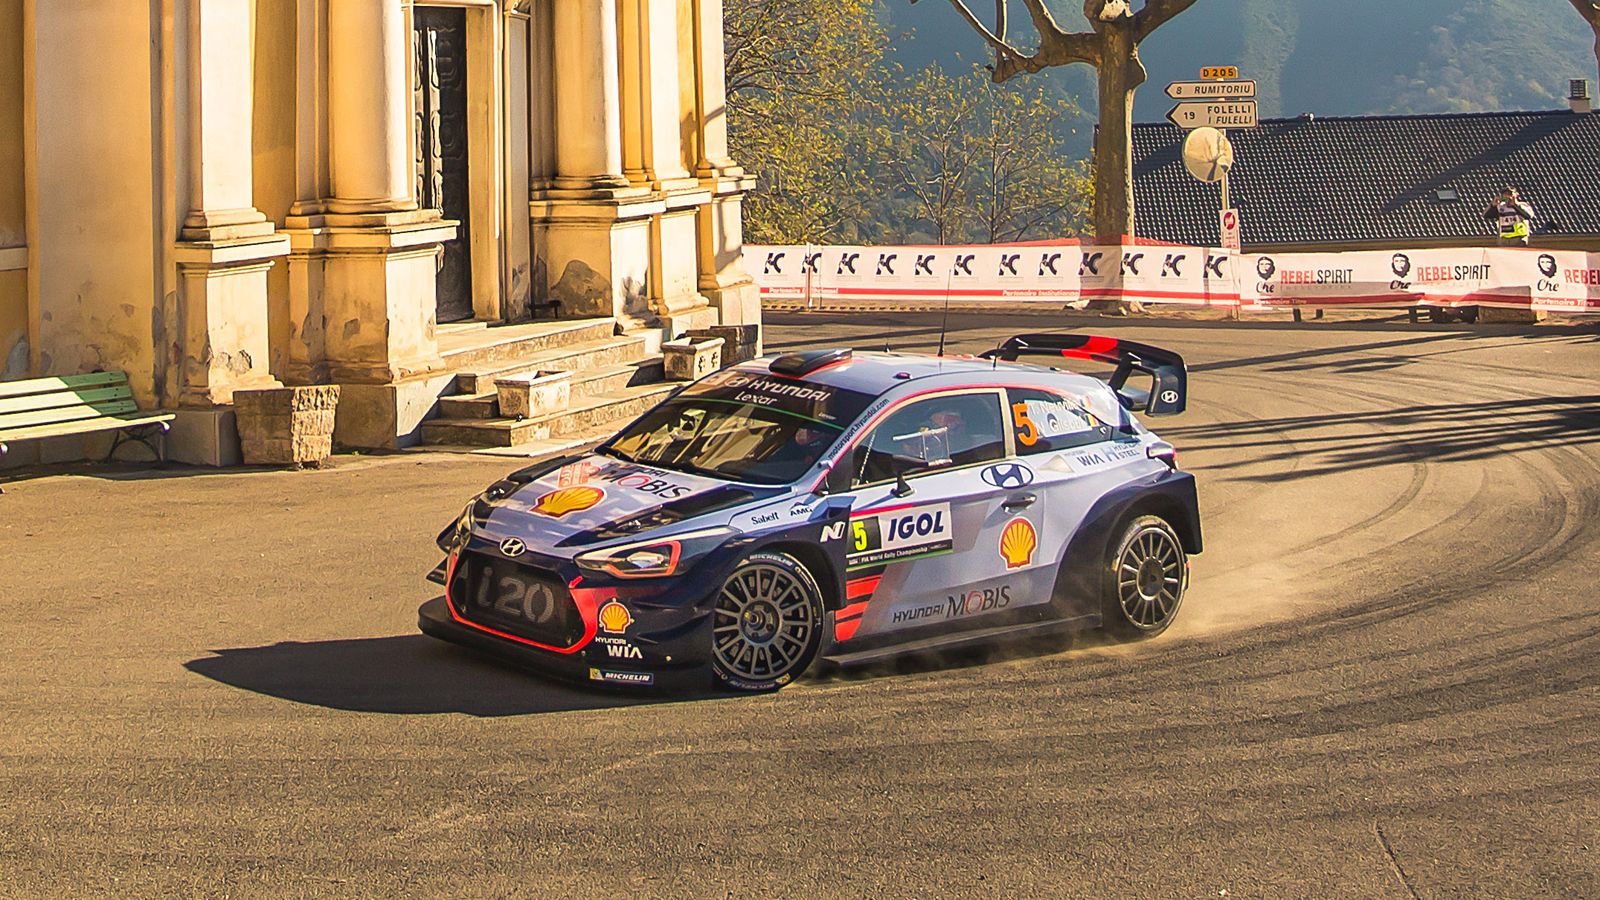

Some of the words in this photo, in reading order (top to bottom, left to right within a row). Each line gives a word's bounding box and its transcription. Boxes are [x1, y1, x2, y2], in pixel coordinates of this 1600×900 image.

[1203, 69, 1209, 77] D
[1212, 68, 1234, 77] 205
[1176, 87, 1182, 95] 8
[1194, 85, 1251, 95] RUMITORIU
[1184, 112, 1195, 120] 19
[1207, 106, 1251, 114] FOLELLI
[1216, 116, 1252, 124] FULELLI
[1281, 269, 1353, 284] REBELSPIRIT
[1417, 265, 1491, 282] REBELSPIRIT
[748, 379, 831, 401] HYUNDAI
[735, 391, 778, 405] Lexar
[1012, 403, 1038, 446] 5
[1077, 454, 1105, 466] WIA
[1119, 450, 1140, 459] STEEL
[751, 512, 779, 525] Sabelt
[888, 511, 944, 541] IGOL
[852, 521, 867, 551] 5
[477, 566, 555, 624] i20
[893, 604, 944, 623] HYUNDAI
[946, 585, 1010, 618] MOBIS
[595, 636, 627, 645] HYUNDAI
[607, 643, 643, 660] WIA
[605, 673, 650, 681] MICHELIN
